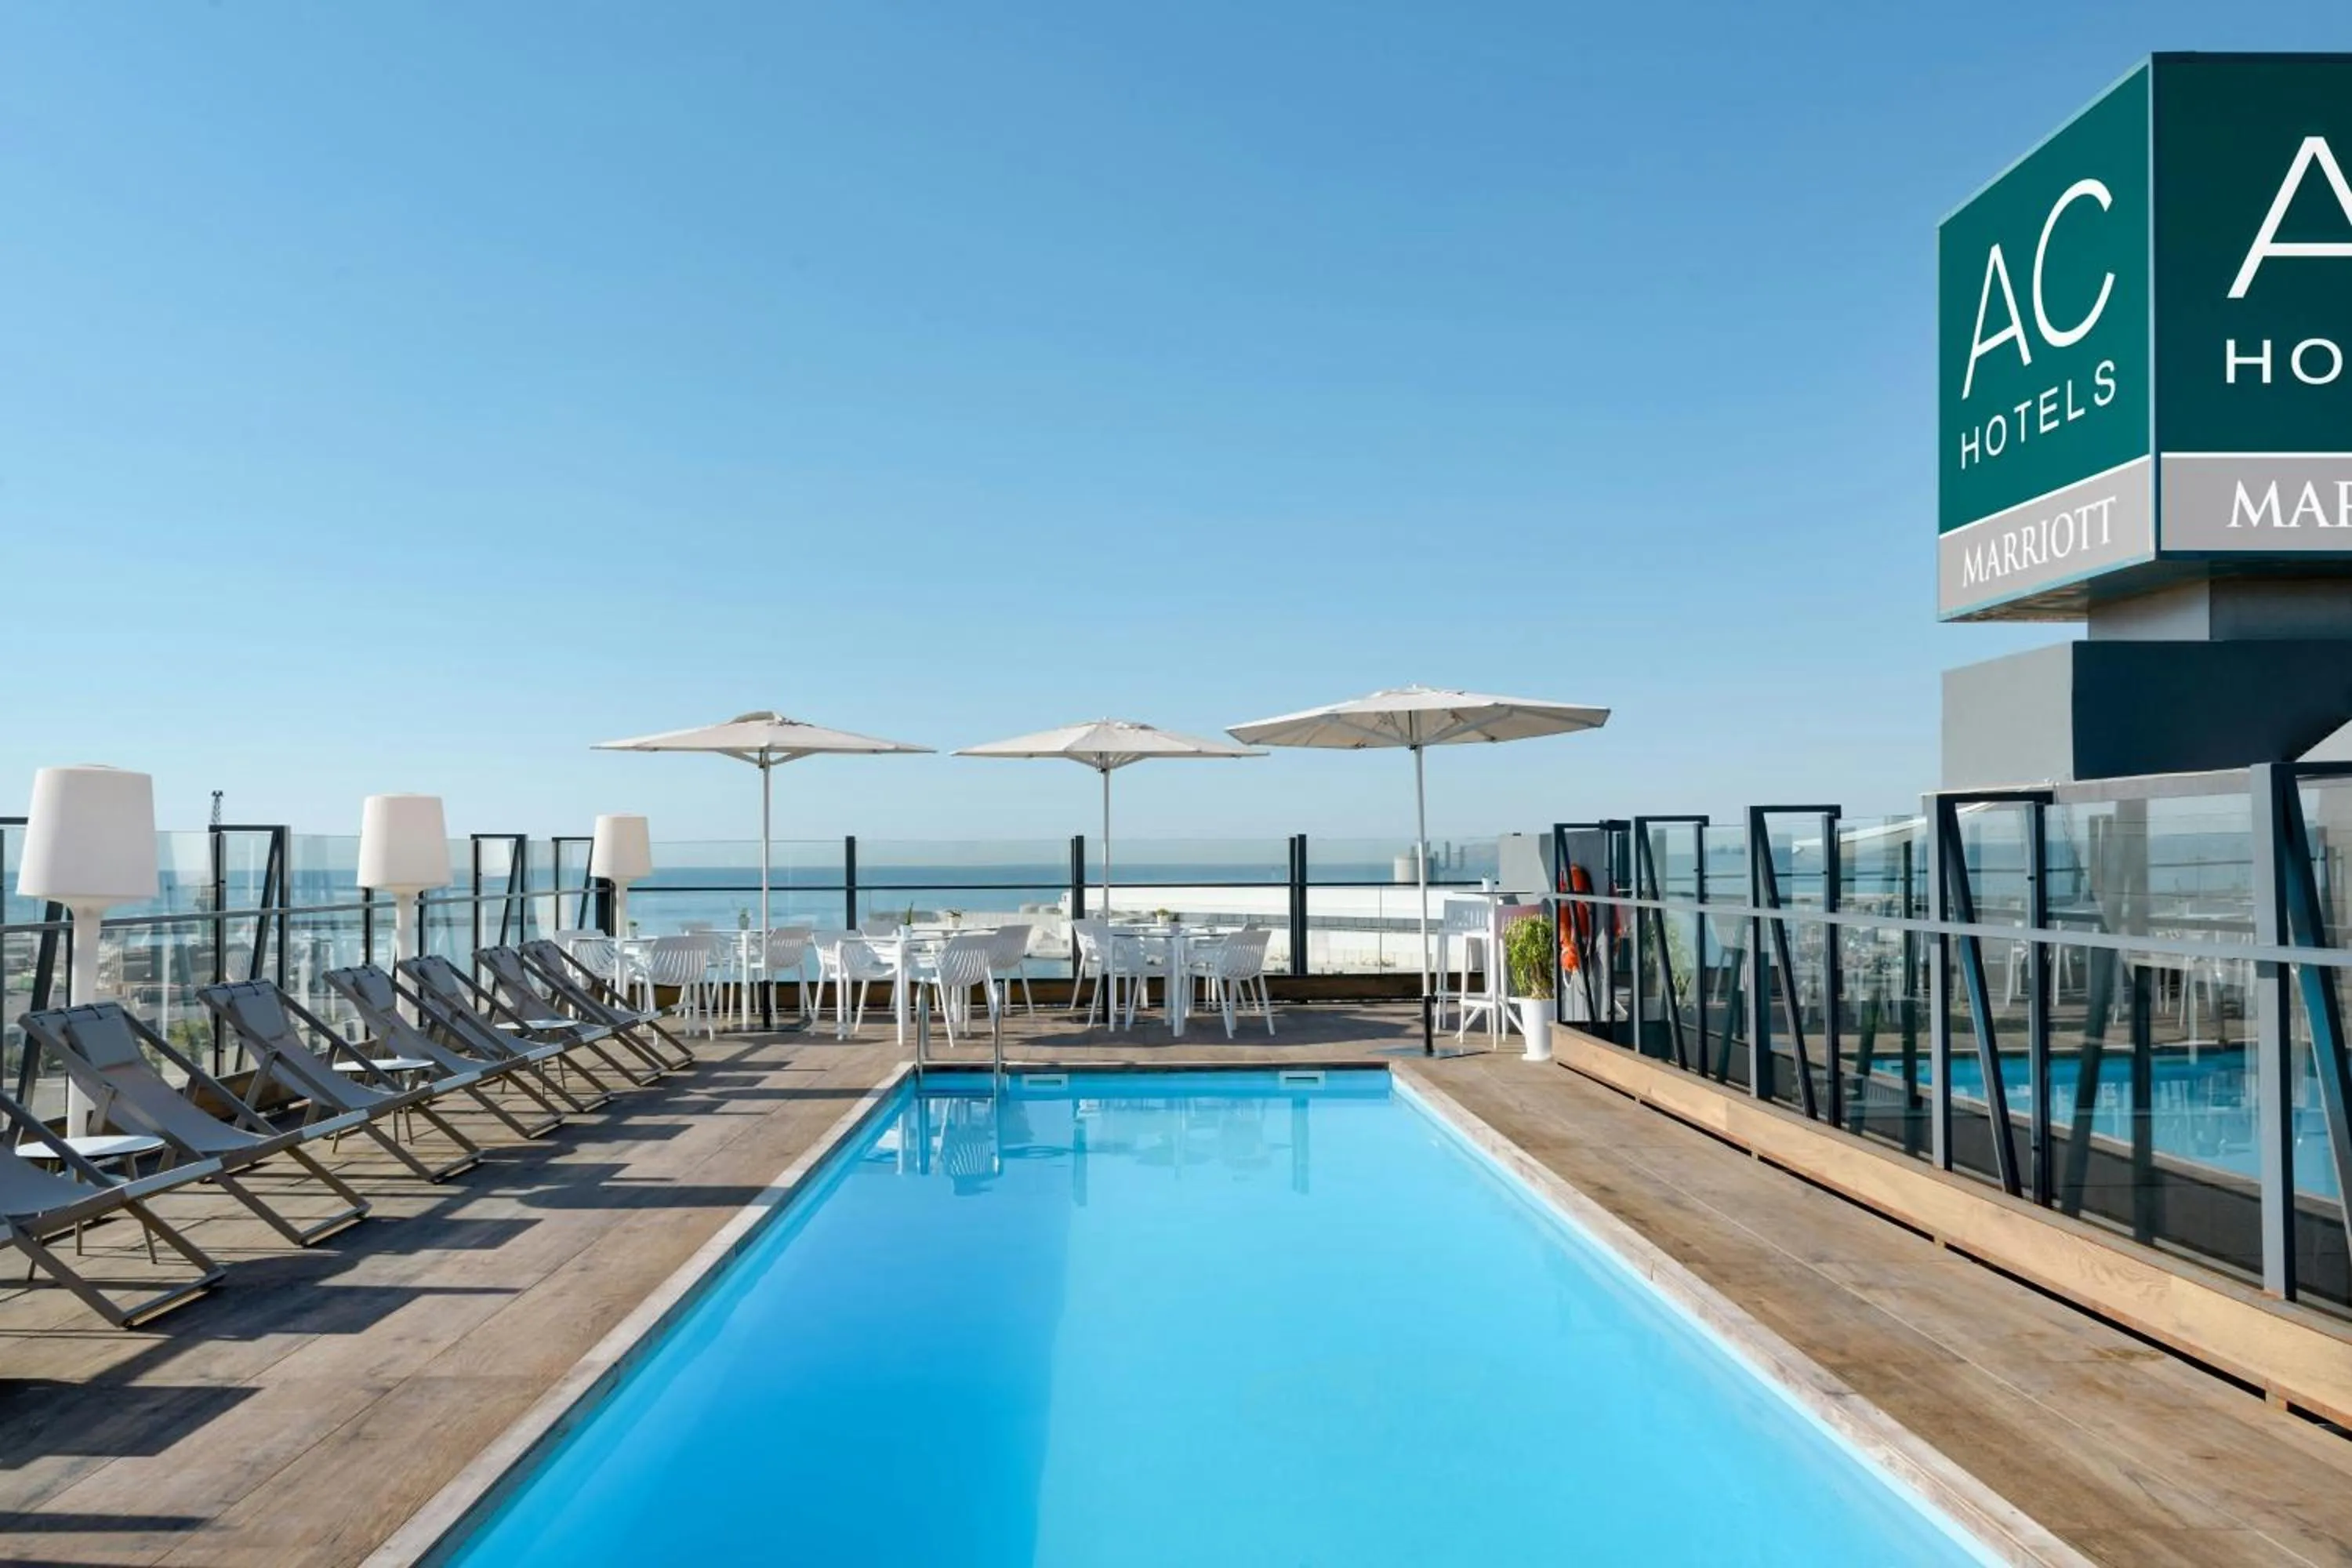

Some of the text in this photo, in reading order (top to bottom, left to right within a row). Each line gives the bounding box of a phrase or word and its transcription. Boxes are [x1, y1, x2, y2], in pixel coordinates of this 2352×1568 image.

[1962, 178, 2115, 399] AC
[2226, 338, 2343, 385] HO
[1961, 360, 2116, 470] HOTELS
[1962, 495, 2116, 588] MARRIOTT
